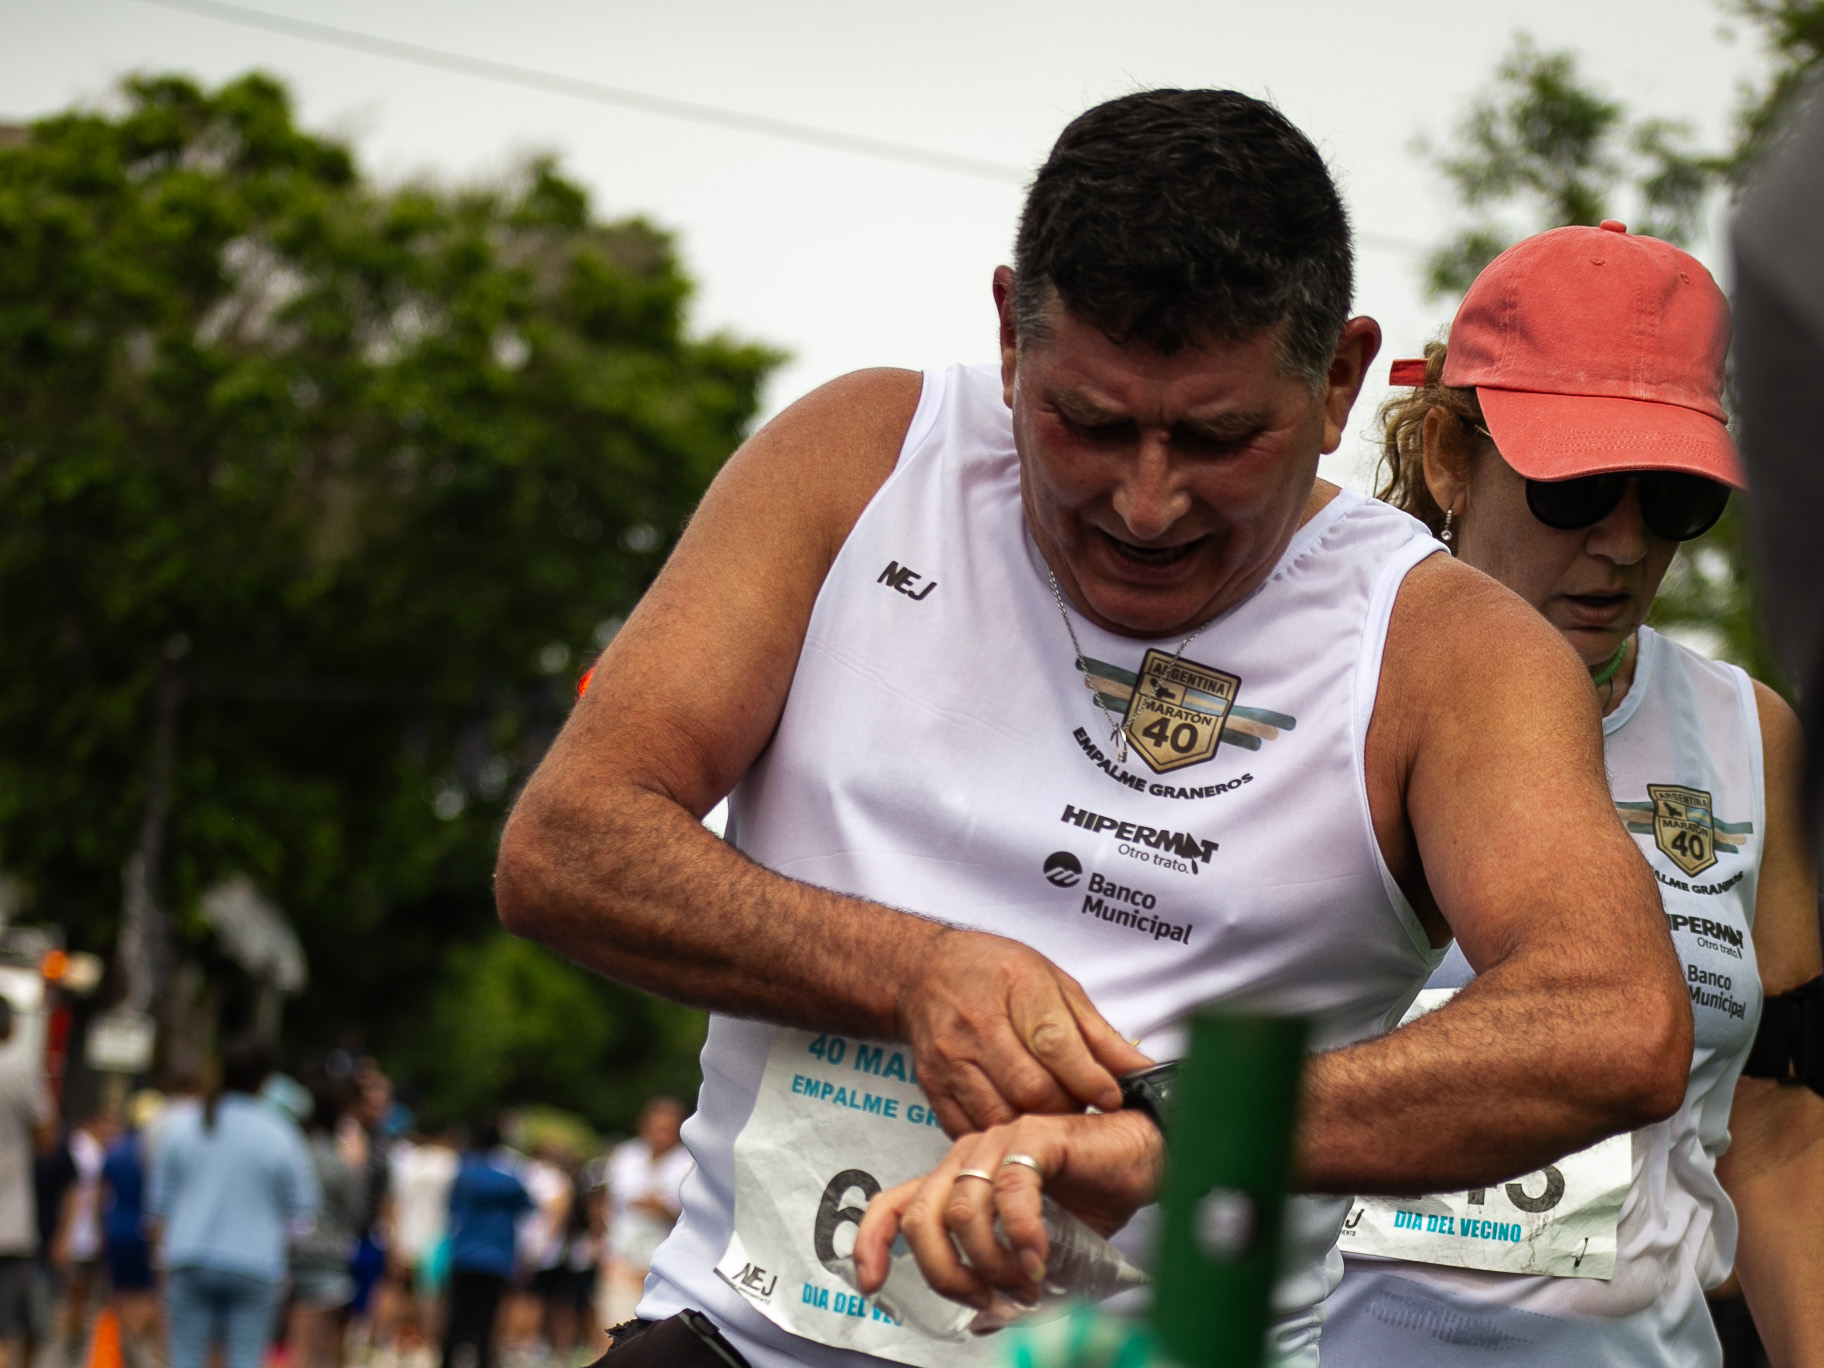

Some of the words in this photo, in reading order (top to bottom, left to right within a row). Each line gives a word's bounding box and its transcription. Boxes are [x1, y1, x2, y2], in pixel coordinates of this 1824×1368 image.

[877, 560, 938, 601] NEJ
[1152, 662, 1227, 695] ARGENTINA
[1142, 700, 1213, 727] MARATÓN
[1142, 717, 1199, 754] 40
[1072, 726, 1146, 793] EMPALME
[1148, 772, 1254, 800] GRANEROS
[1118, 843, 1150, 862] Otro
[1152, 853, 1190, 874] trato.
[1671, 830, 1705, 861] 40
[1088, 872, 1157, 910] Banco
[1081, 894, 1193, 946] Municipal
[1696, 937, 1719, 952] Otro
[1687, 964, 1732, 991] Banco
[1689, 985, 1747, 1021] Municipal
[808, 1033, 847, 1066] 40
[791, 1074, 900, 1120] EMPALME
[1394, 1210, 1422, 1232] DIA
[1426, 1214, 1454, 1236] DEL
[1460, 1217, 1522, 1244] VECINO
[802, 1282, 829, 1311] DIA
[833, 1291, 867, 1318] DEL
